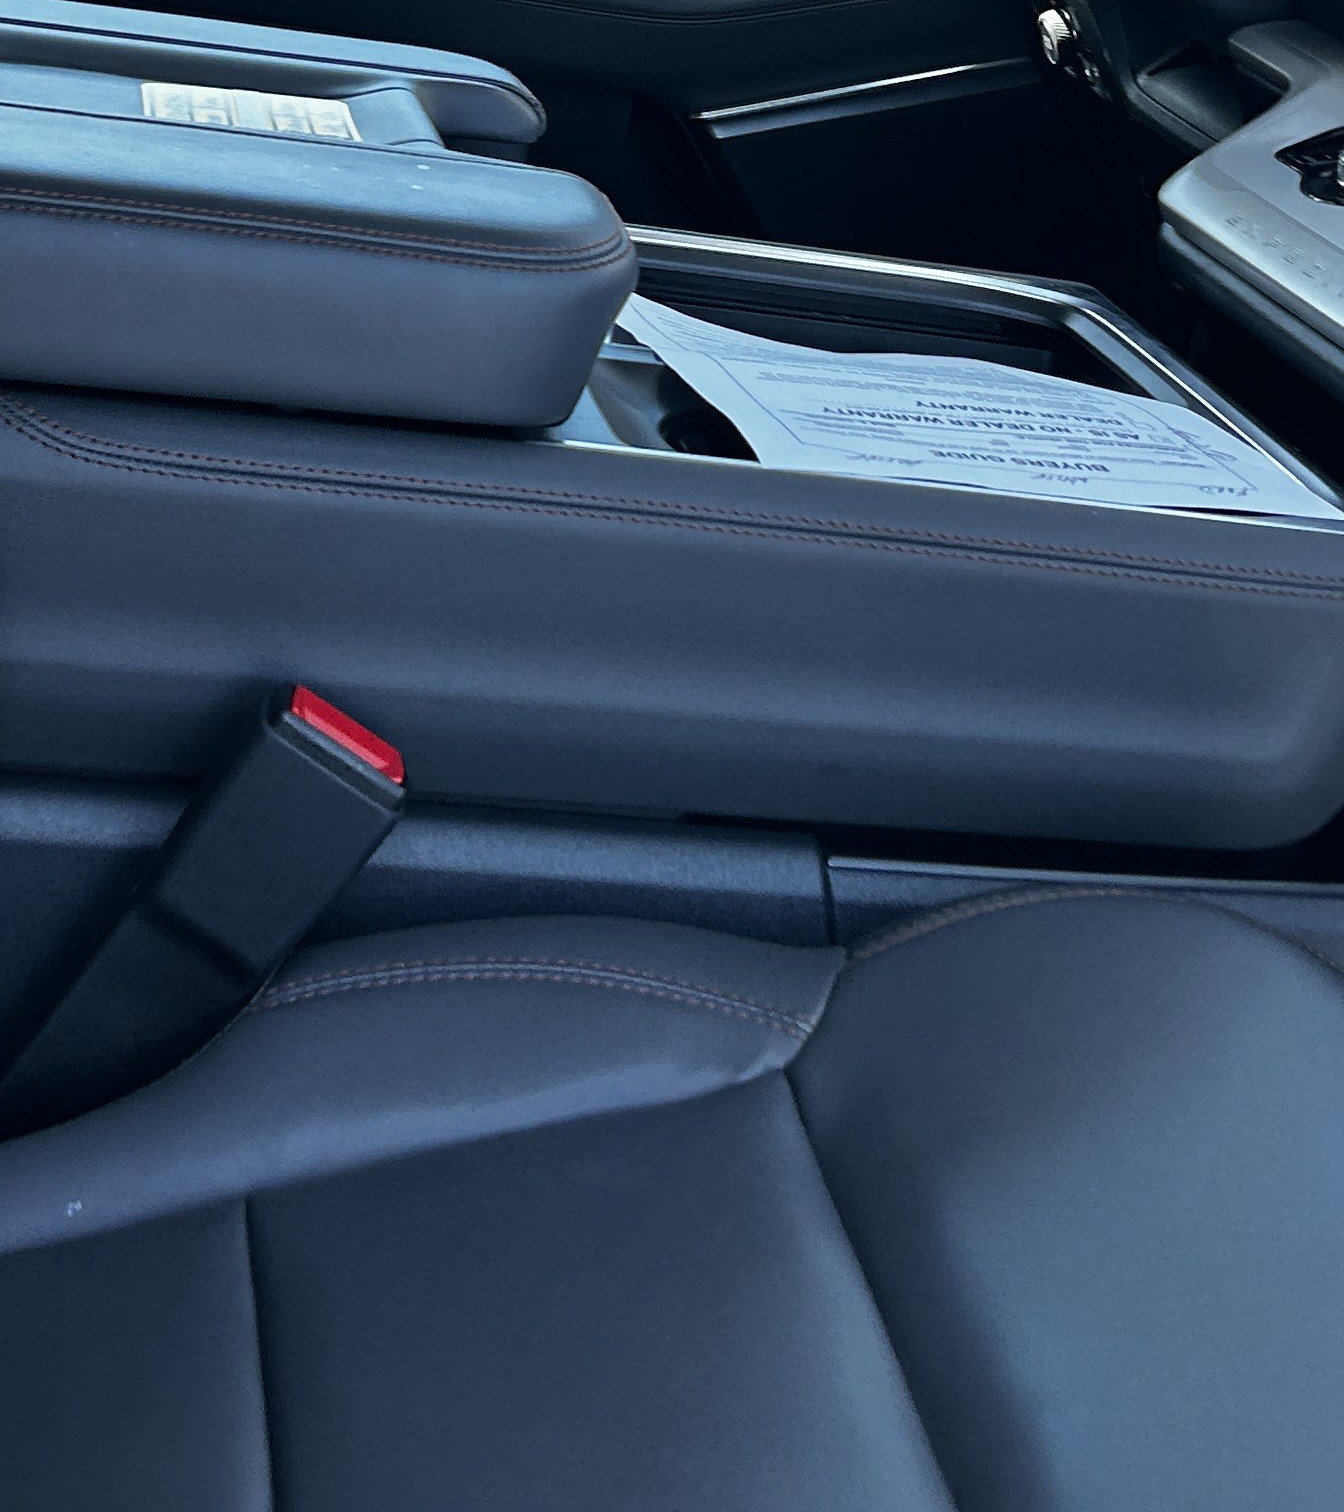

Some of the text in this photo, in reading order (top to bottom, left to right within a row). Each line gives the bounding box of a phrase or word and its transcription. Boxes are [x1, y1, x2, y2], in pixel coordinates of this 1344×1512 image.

[822, 405, 942, 426] WARRANTY
[914, 399, 1124, 426] DEALER WARRANTY
[946, 418, 1039, 432] DEALER
[1042, 425, 1070, 435] NO
[1116, 429, 1140, 439] AS
[930, 449, 1005, 464] GUIDE
[1010, 456, 1110, 473] BUYERS
